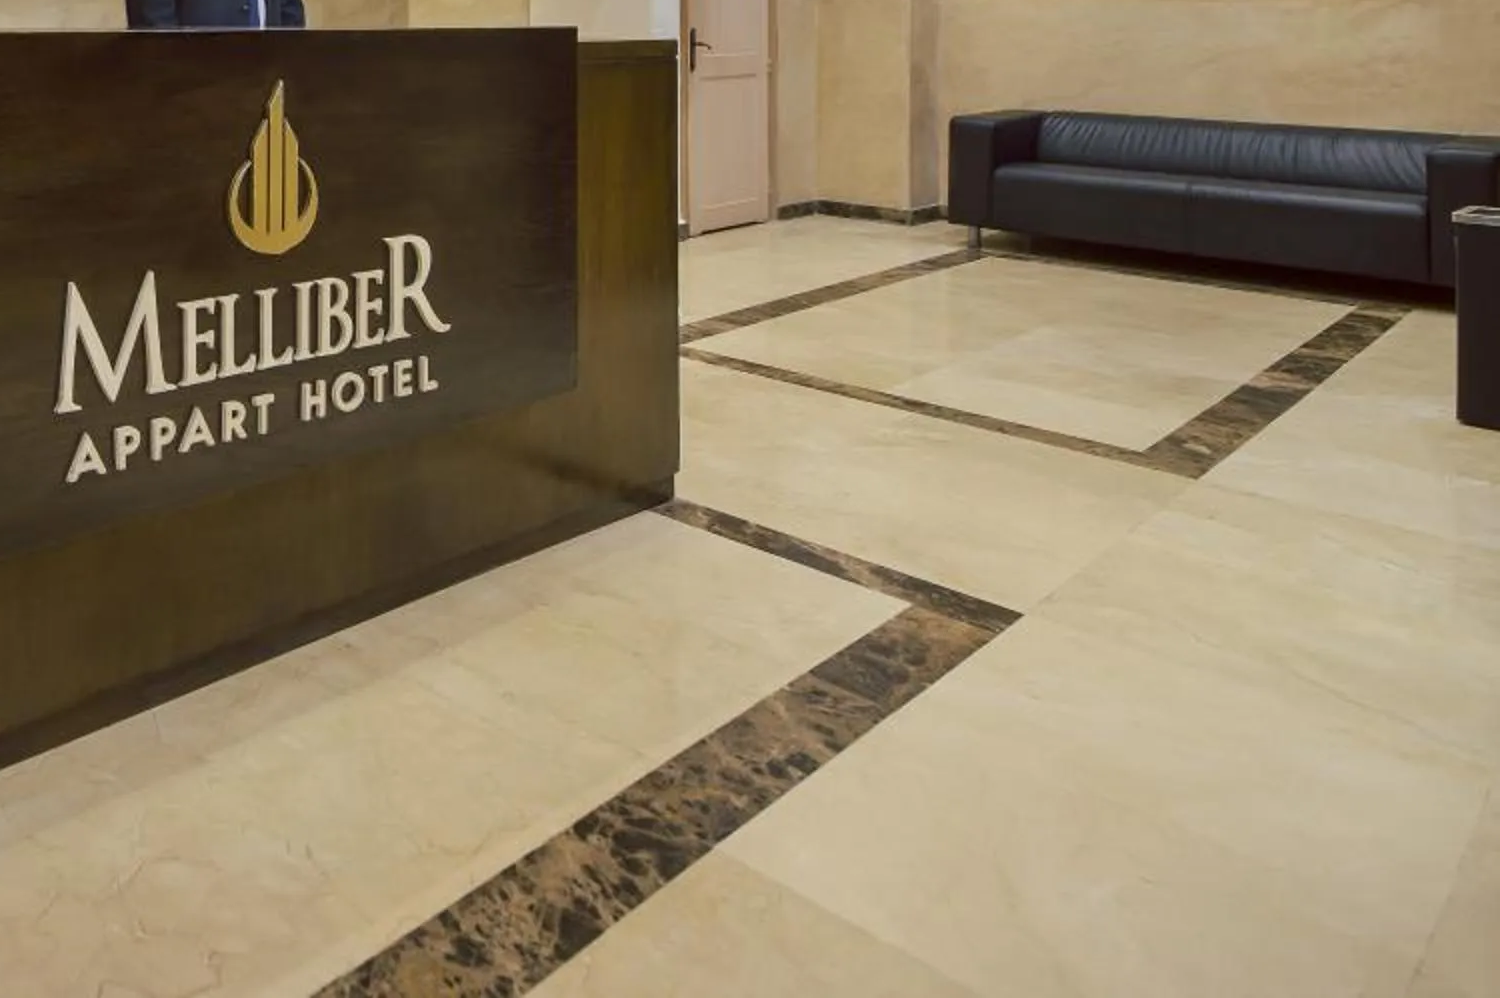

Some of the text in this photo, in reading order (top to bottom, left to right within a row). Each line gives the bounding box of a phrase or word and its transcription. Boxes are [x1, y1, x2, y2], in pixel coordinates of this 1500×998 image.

[53, 233, 451, 415] MELLIBER
[65, 355, 439, 484] APPART HOTEL
